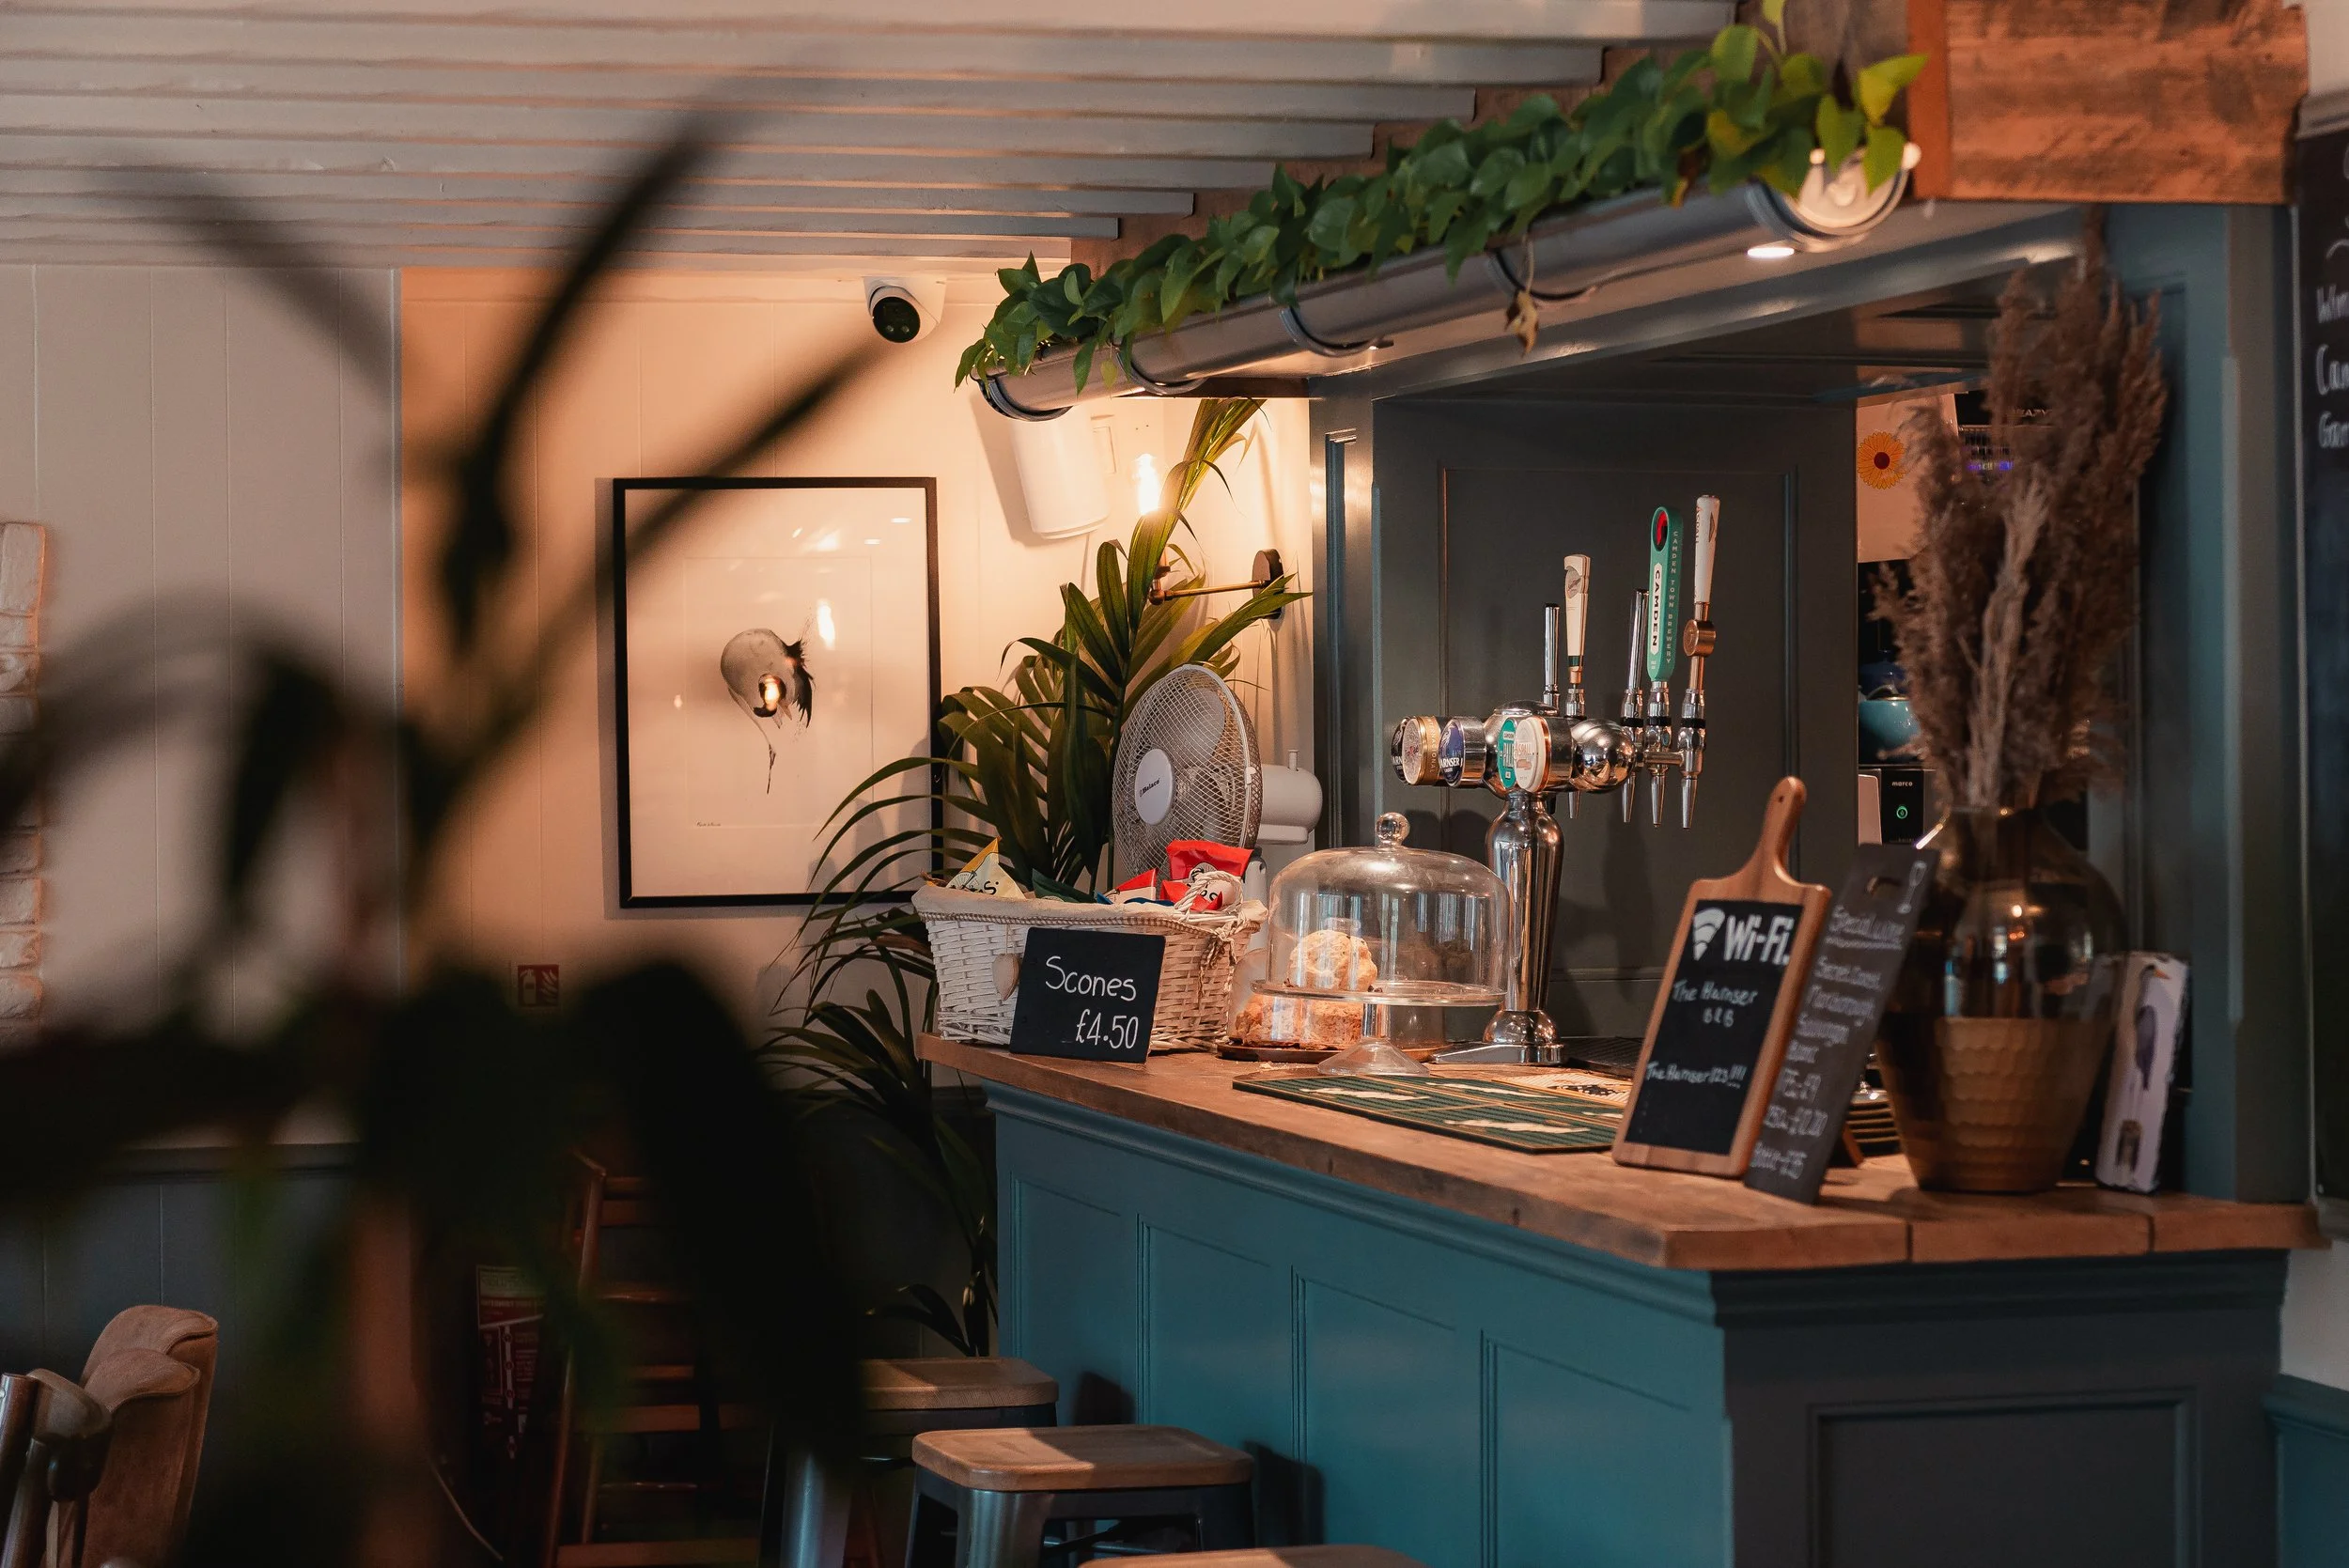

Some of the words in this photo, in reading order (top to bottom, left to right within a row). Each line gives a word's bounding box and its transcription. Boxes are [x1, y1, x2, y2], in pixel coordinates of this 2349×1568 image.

[1652, 569, 1660, 646] CAMDEN
[1045, 955, 1137, 1001] Scones
[1673, 979, 1698, 1002] The
[1076, 1008, 1140, 1049] £4.50
